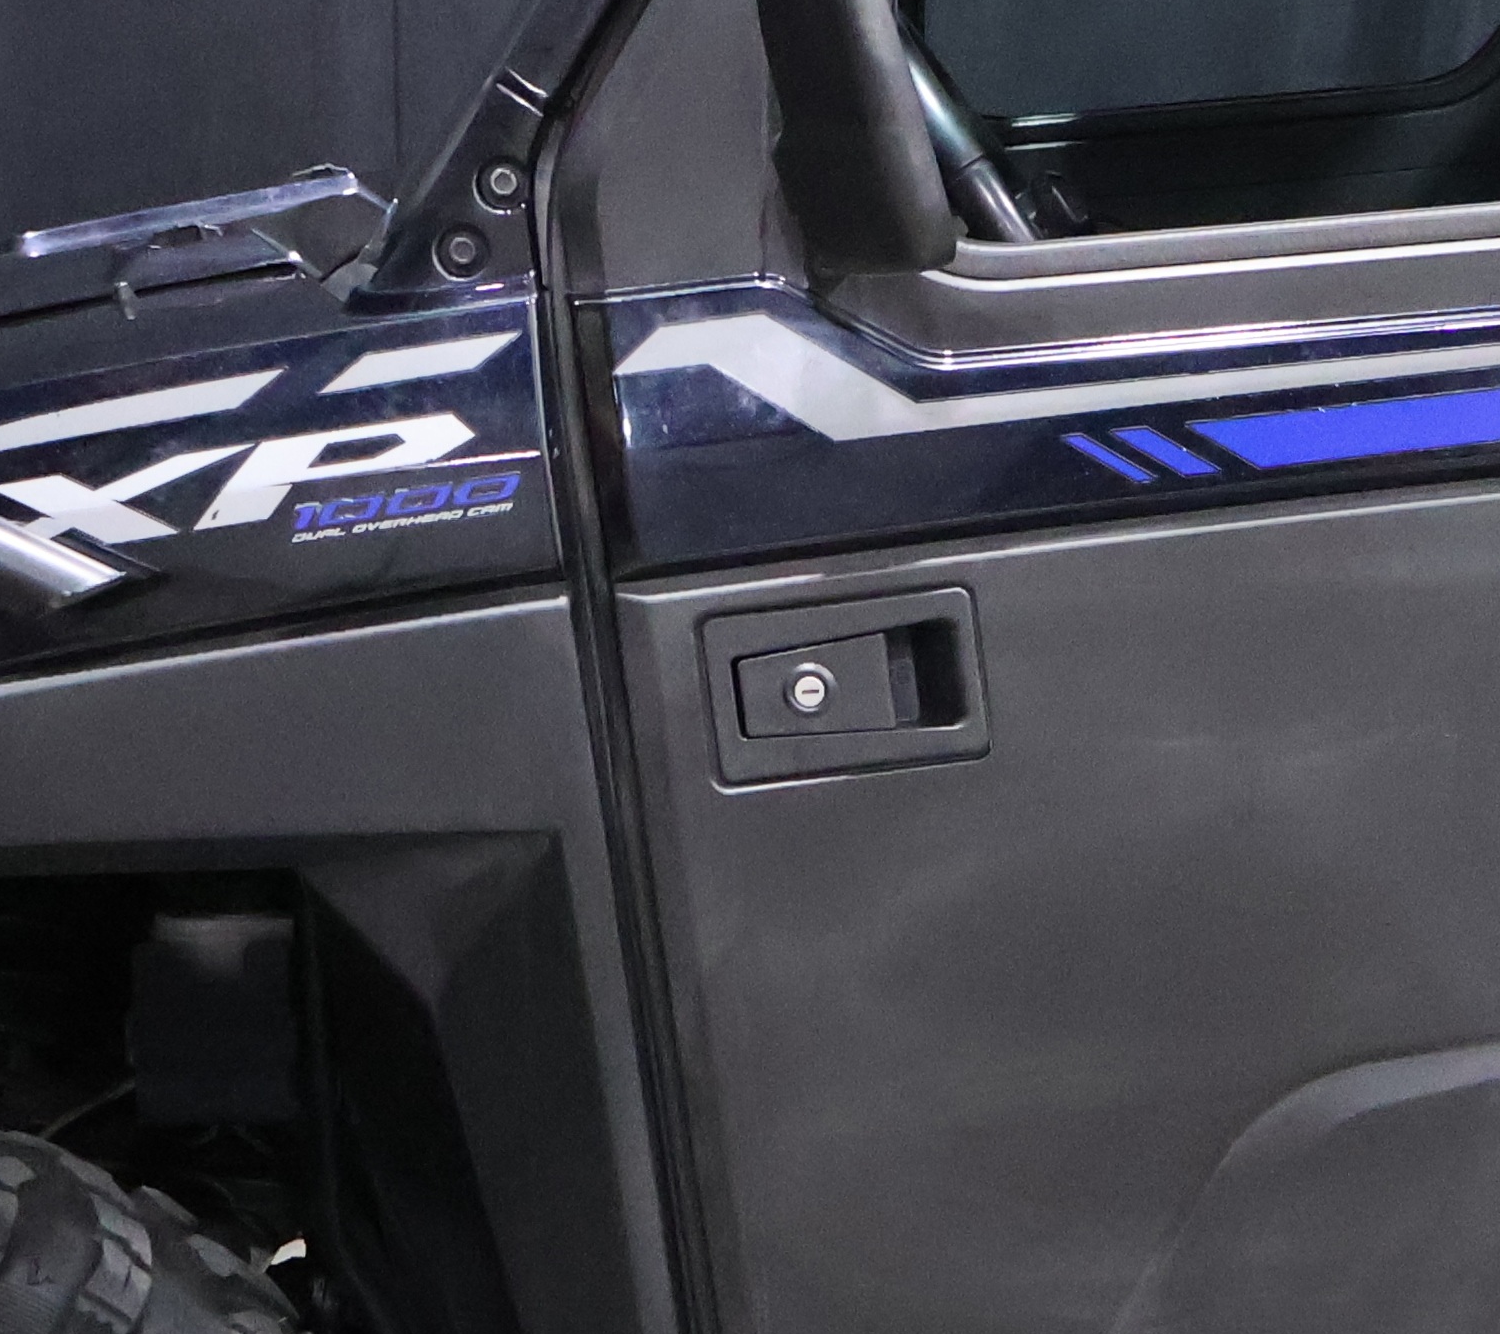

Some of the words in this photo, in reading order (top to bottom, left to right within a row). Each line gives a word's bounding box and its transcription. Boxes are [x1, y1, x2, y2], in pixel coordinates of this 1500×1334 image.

[291, 526, 347, 544] DUAL
[351, 508, 465, 535] OVERHEAD
[466, 501, 514, 518] CAM
[293, 470, 522, 530] 1000
